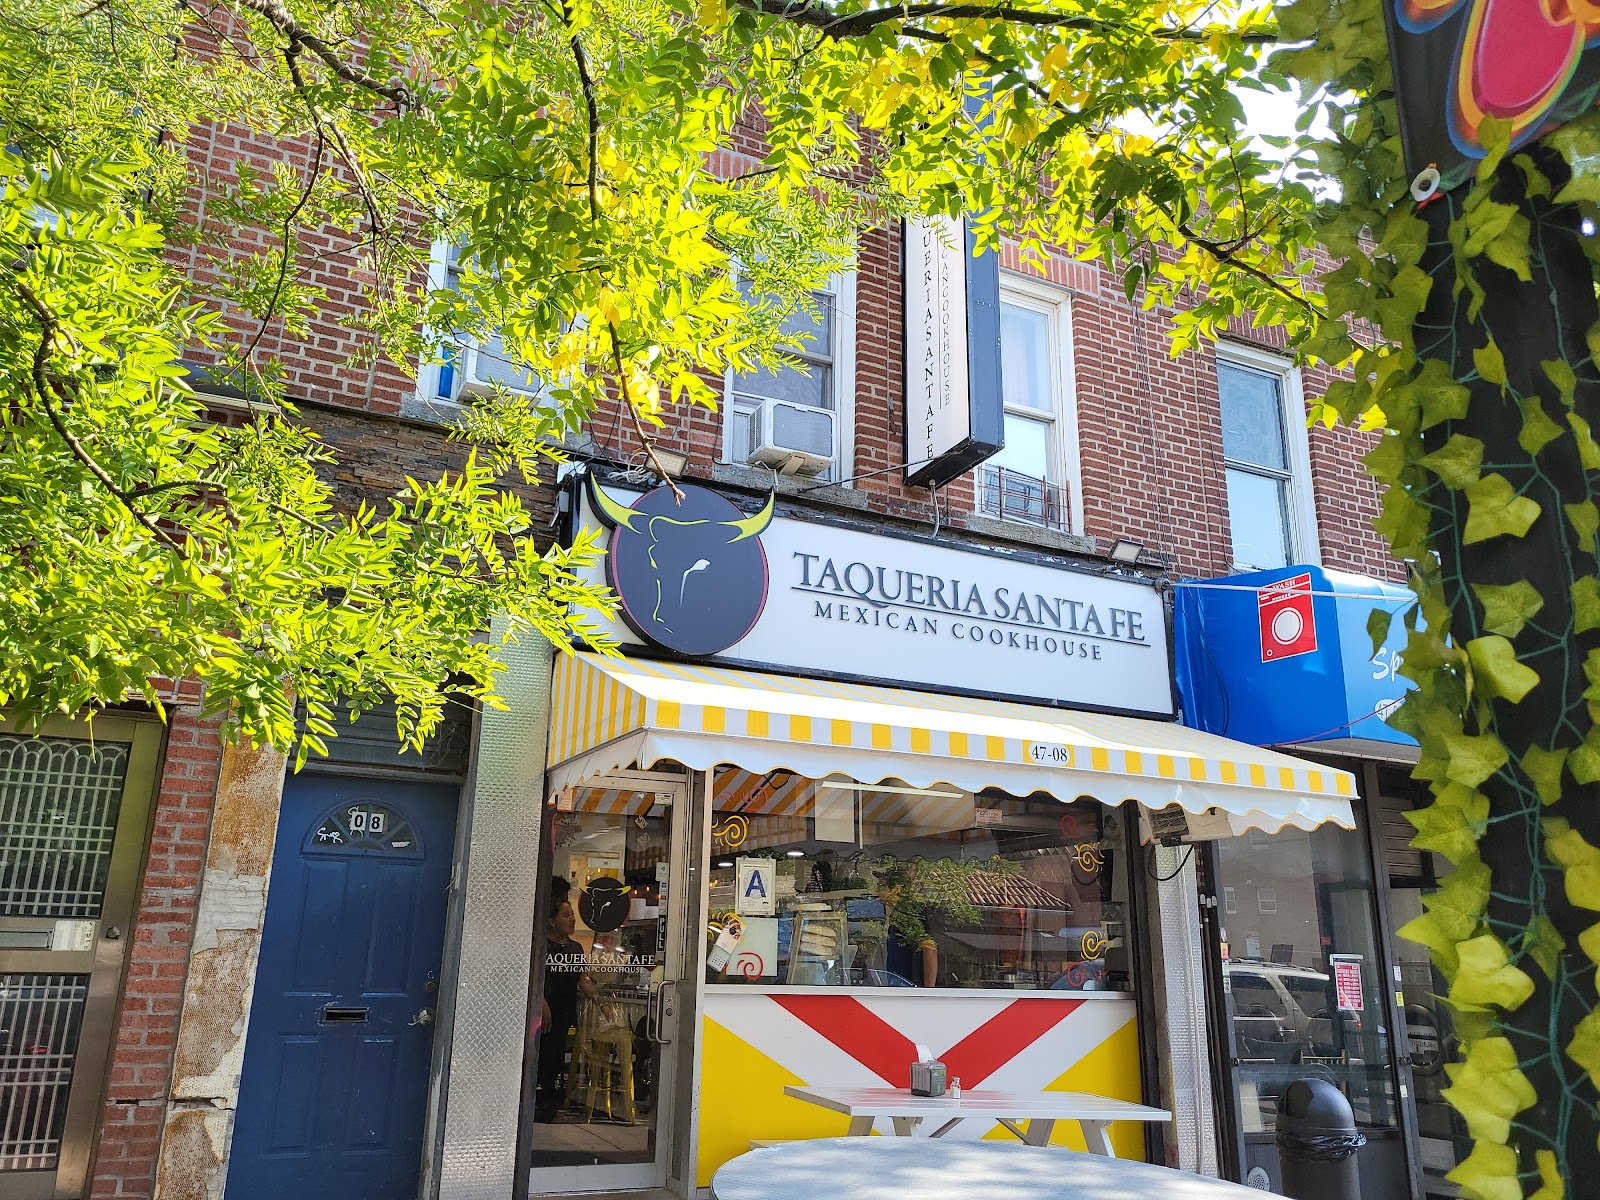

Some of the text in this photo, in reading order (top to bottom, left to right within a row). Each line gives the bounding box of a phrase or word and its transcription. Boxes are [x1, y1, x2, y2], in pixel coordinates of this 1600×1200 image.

[792, 551, 1147, 641] TAQUERIA SANTA FE
[814, 600, 1103, 661] MEXICAN COOKHOUSE
[1031, 745, 1068, 762] 47-08
[744, 869, 767, 898] A
[658, 917, 666, 949] PULL
[545, 953, 600, 966] AQUERIA
[550, 965, 645, 974] MEXICAN COOKHOUSE
